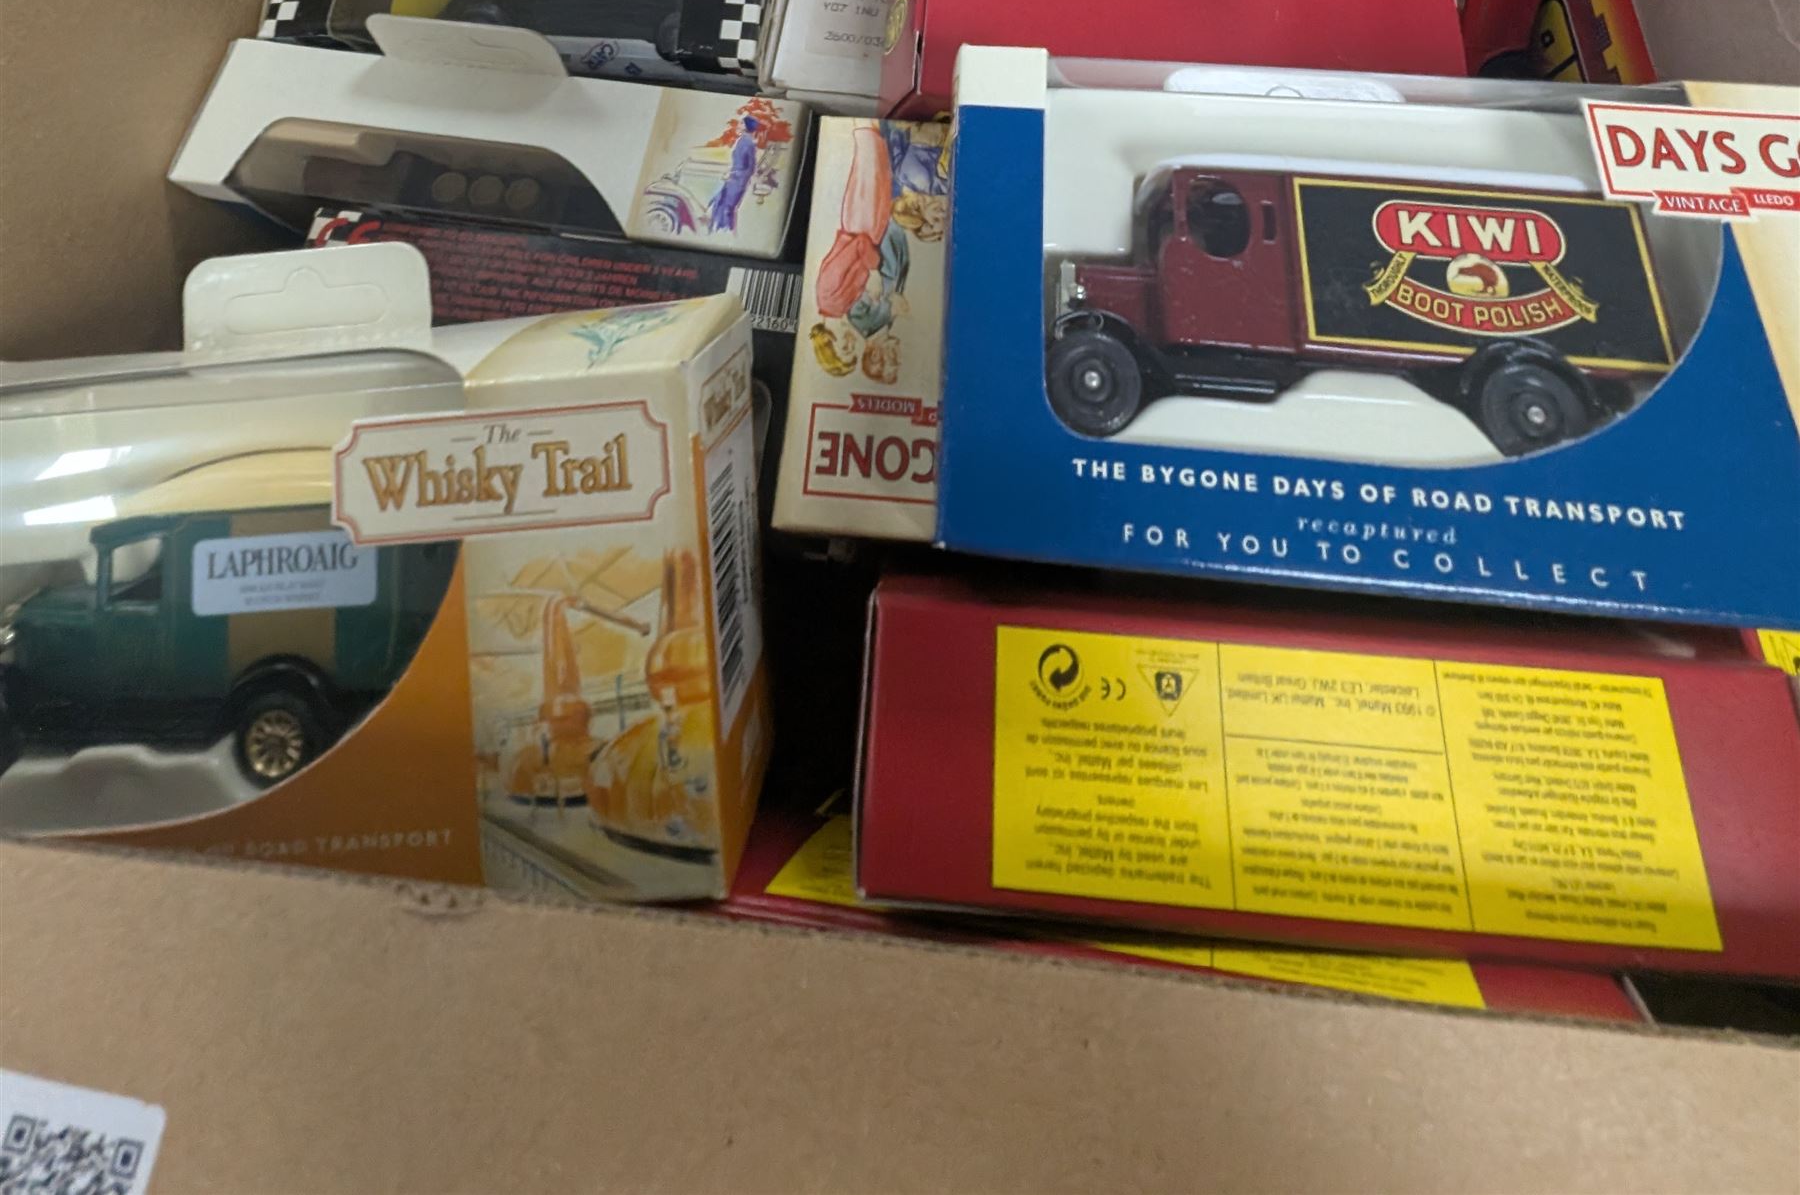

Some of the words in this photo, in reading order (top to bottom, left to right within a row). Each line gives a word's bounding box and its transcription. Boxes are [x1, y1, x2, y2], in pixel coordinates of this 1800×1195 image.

[1606, 124, 1747, 175] DAYS
[1664, 195, 1745, 213] VINTAGE
[1753, 194, 1795, 207] LLEDO
[1397, 209, 1542, 255] KIWI
[1396, 284, 1465, 323] BOOT
[1472, 297, 1564, 329] POLISH
[858, 398, 916, 414] MODELS
[483, 423, 521, 444] The
[362, 444, 523, 515] Whisky
[530, 432, 633, 499] Trail
[814, 430, 937, 483] GONE
[1073, 458, 1127, 482] THE
[1141, 462, 1259, 494] BYGONE
[1273, 475, 1346, 502] DAYS
[1360, 481, 1399, 506] OF
[1412, 486, 1495, 515] ROAD
[1504, 496, 1687, 531] TRANSPORT
[1296, 515, 1459, 547] recaptured
[206, 541, 359, 582] LAPHROAIG
[1122, 523, 1190, 550] FOR
[1216, 532, 1290, 559] YOU
[1317, 540, 1362, 566] TO
[1393, 548, 1650, 592] COLLECT
[1100, 676, 1127, 702] CE
[315, 827, 452, 854] TRANSPORT
